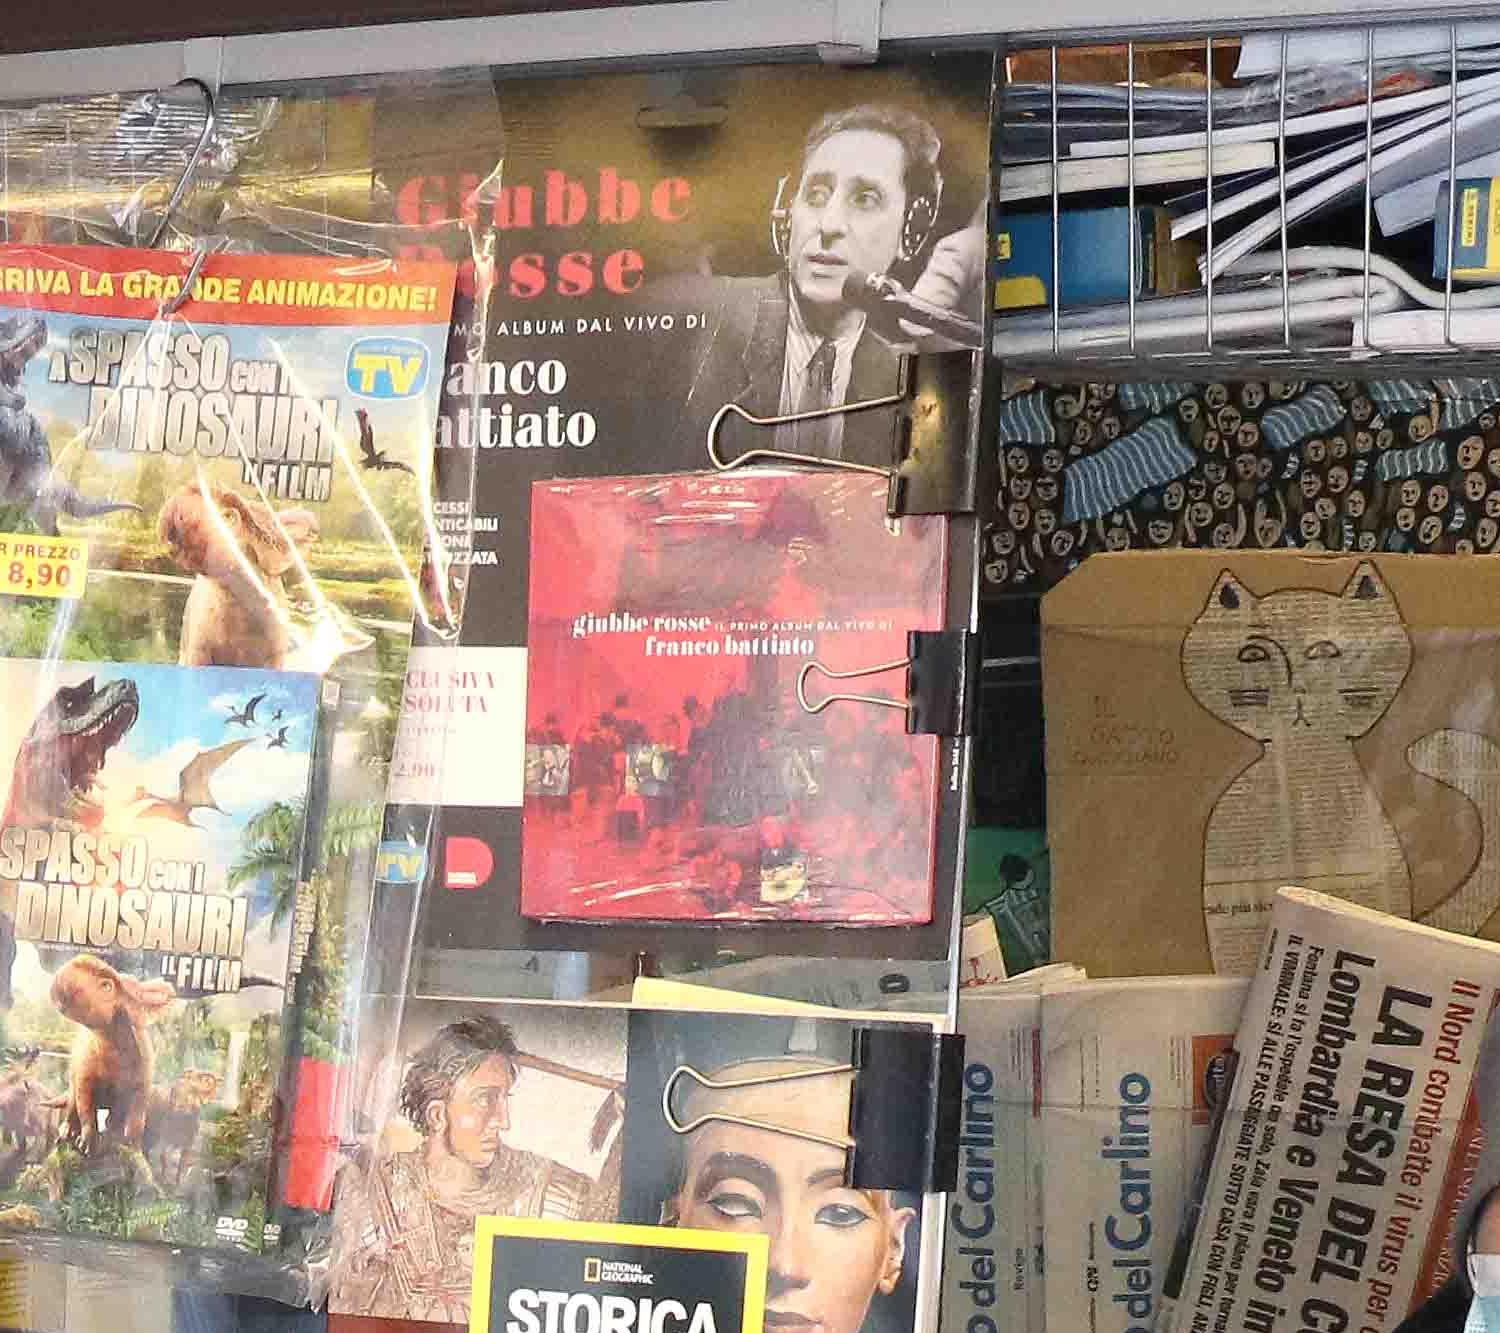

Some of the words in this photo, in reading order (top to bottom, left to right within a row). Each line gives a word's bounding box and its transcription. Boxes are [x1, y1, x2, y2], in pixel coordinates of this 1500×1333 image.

[80, 269, 115, 297] LA
[247, 279, 437, 313] ANIMAZIONE!
[498, 319, 566, 336] ALBUM
[576, 318, 614, 333] DAL
[624, 315, 675, 331] VIVO
[68, 330, 231, 391] SPASSO
[86, 386, 338, 461] DINOSAURI
[263, 466, 332, 501] FILM
[8, 561, 72, 589] 8,90
[14, 543, 81, 561] PREZZO
[573, 611, 648, 638] giubbe
[646, 635, 719, 657] franco
[725, 635, 814, 656] battiato
[13, 882, 245, 947] DINOSAURI
[1293, 949, 1377, 1138] Lombardia
[1372, 985, 1433, 1049] LA
[951, 1062, 995, 1239] Carlino
[1337, 1061, 1413, 1187] RESA
[1102, 1072, 1151, 1250] Carlino
[1256, 1177, 1320, 1293] Veneto
[1309, 1198, 1378, 1286] DEL
[959, 1248, 996, 1306] del
